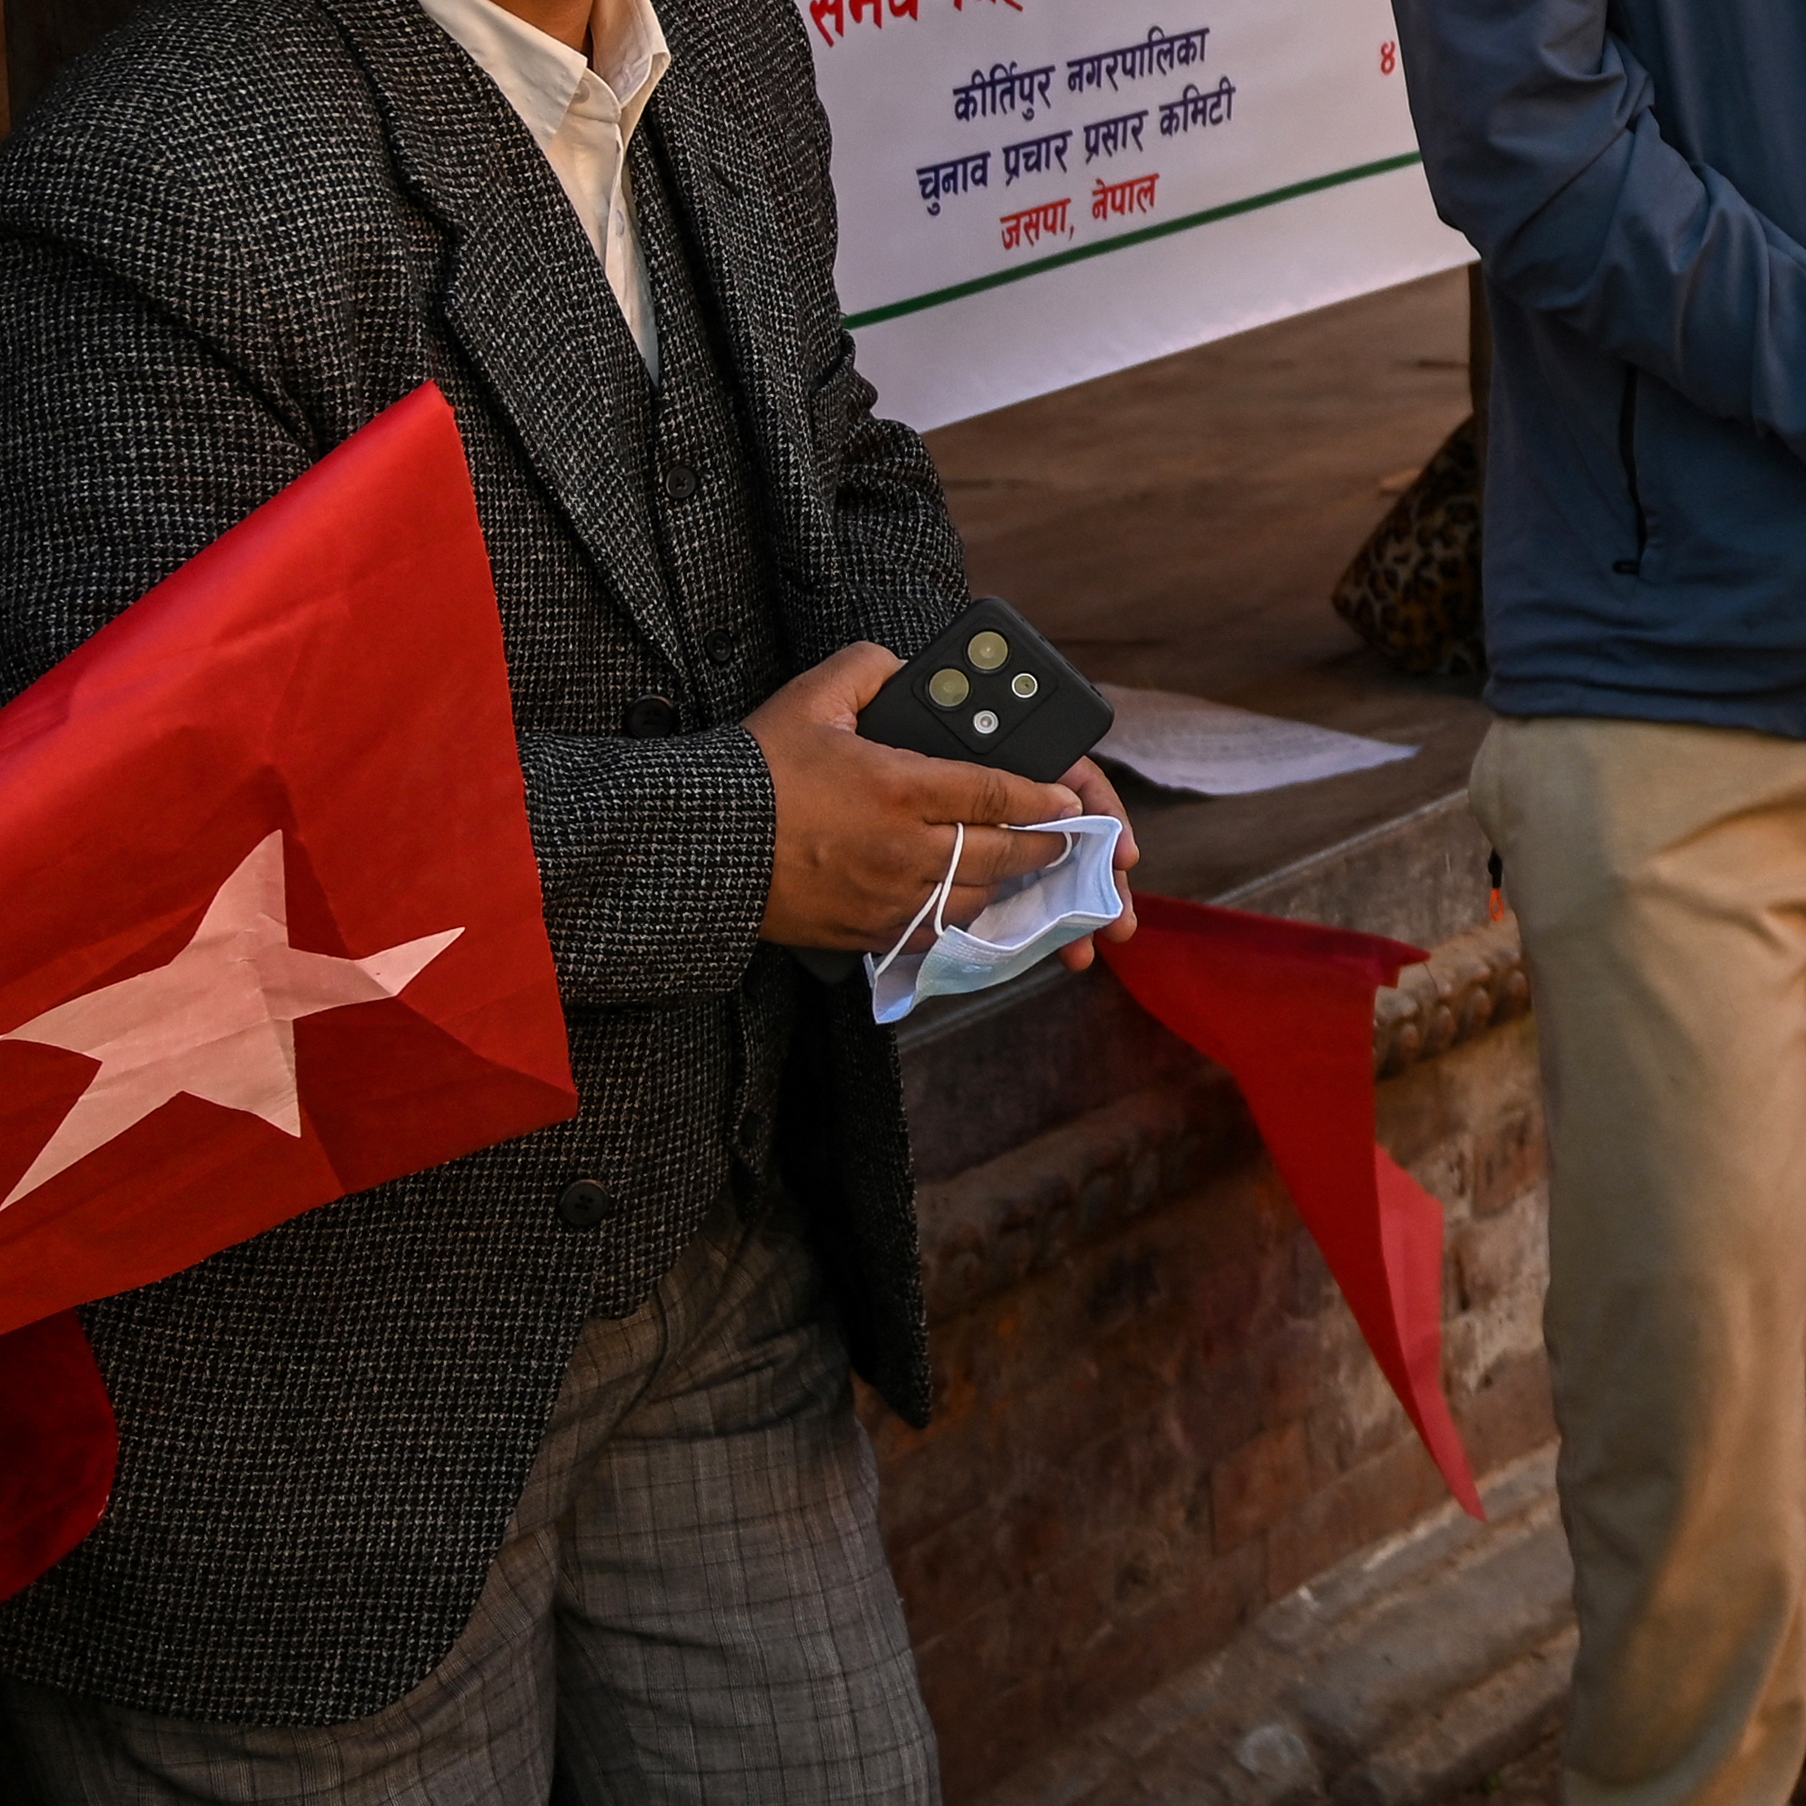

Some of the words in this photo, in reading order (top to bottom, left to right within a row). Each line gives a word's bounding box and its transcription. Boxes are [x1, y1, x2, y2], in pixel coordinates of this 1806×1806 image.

[952, 61, 1056, 122] कीर्तिपुर
[1066, 25, 1210, 93] नगरपालिका
[915, 151, 992, 217] चुनाव
[1002, 130, 1073, 187] प्रचार
[1083, 109, 1149, 164] प्रसार
[1158, 76, 1236, 137] कमिटी
[999, 197, 1076, 251] जसपा,
[1091, 173, 1160, 221] नेपाल
